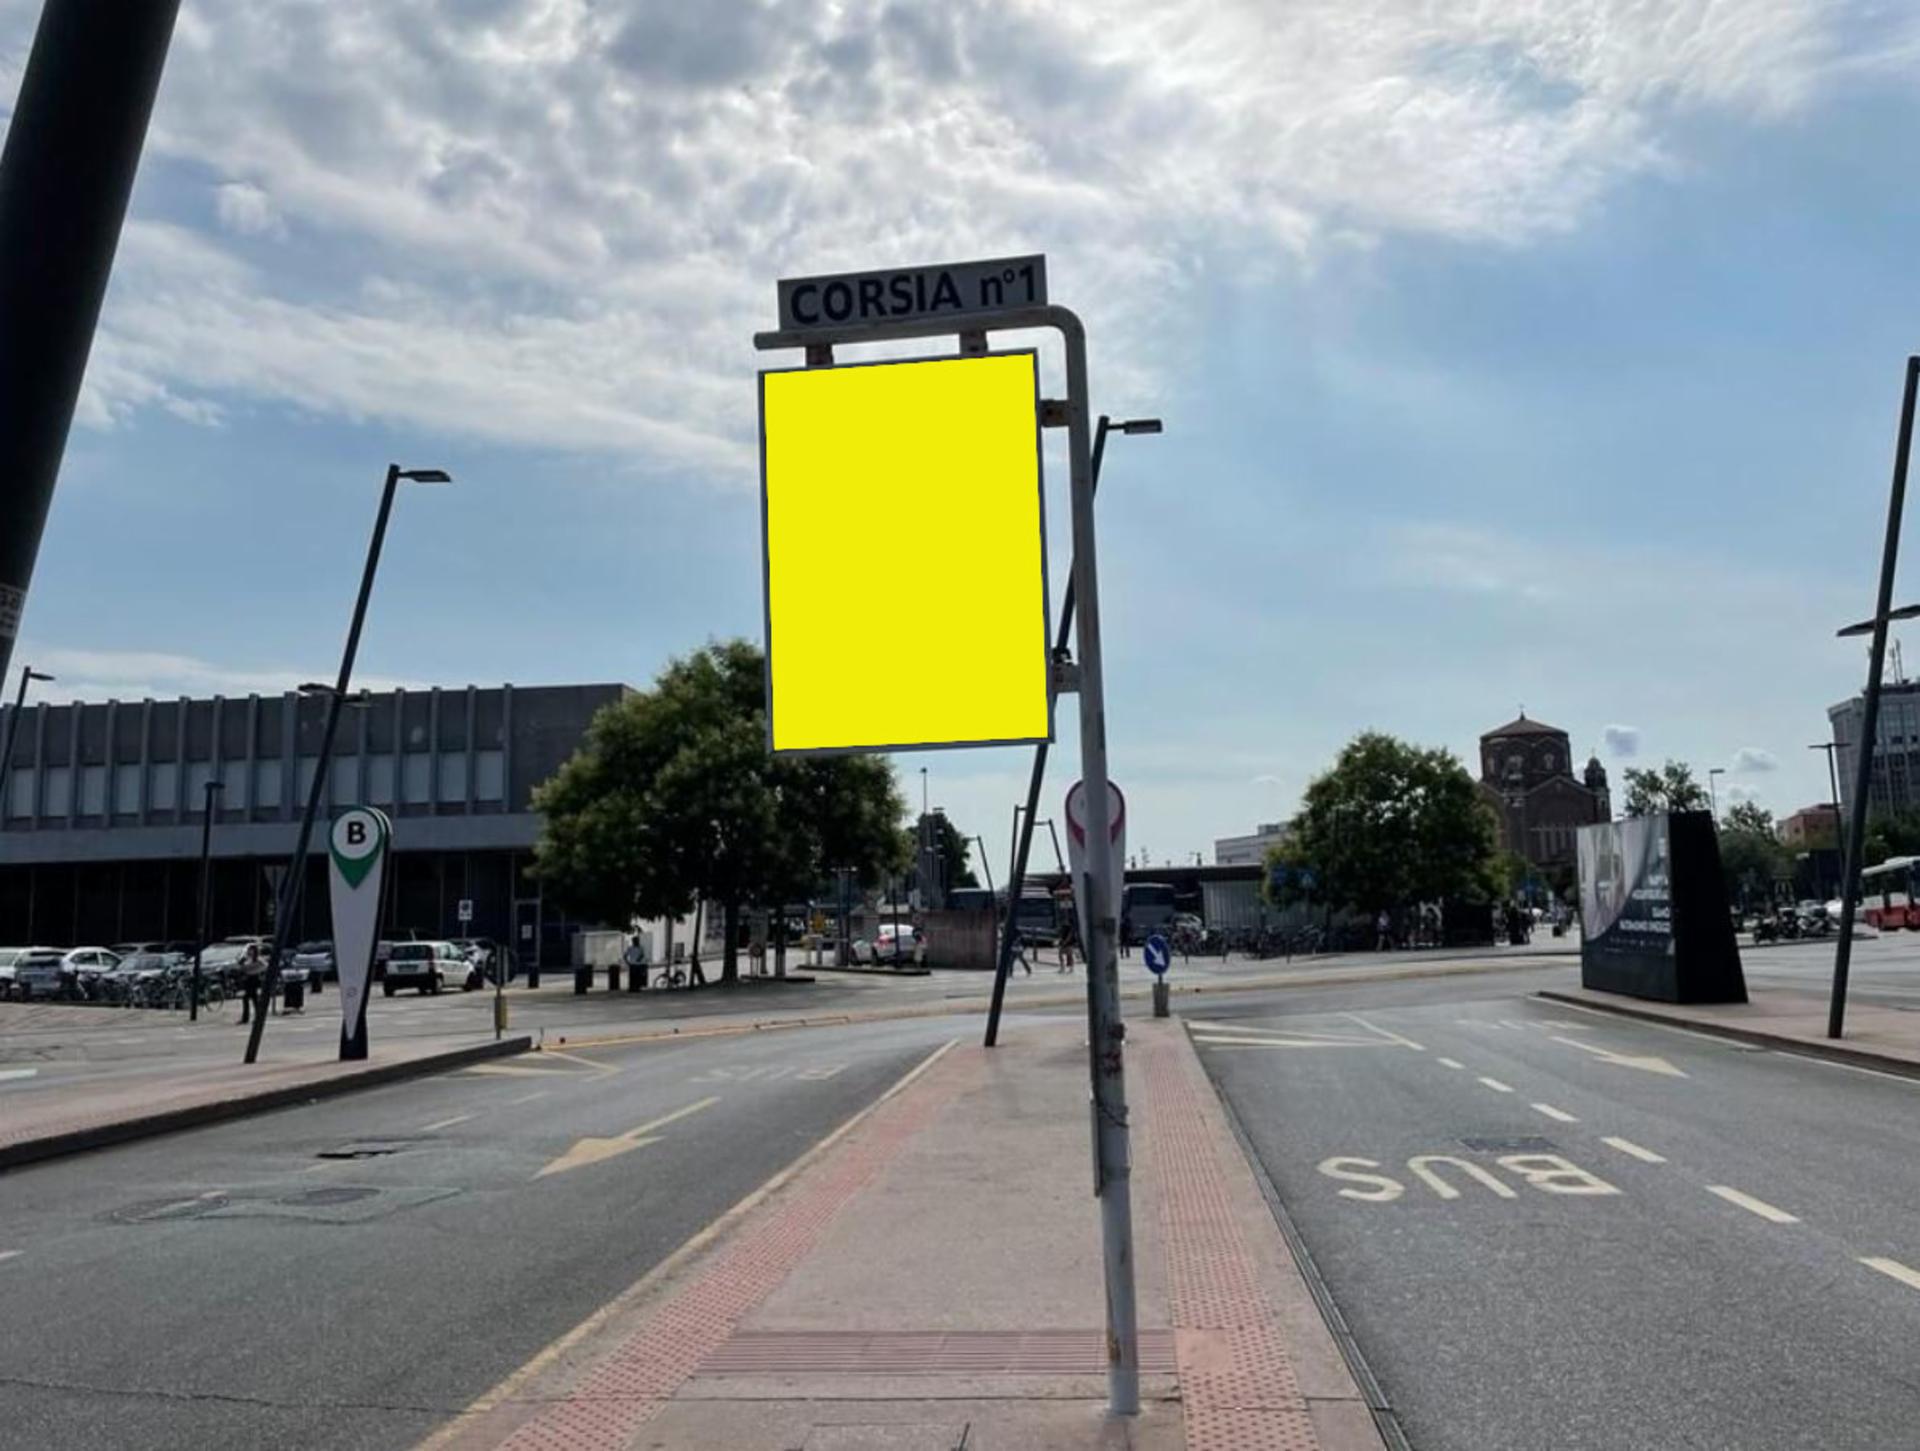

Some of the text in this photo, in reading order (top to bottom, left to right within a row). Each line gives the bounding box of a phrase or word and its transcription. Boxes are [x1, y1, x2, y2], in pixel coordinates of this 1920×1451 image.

[790, 271, 963, 325] CORSIA
[347, 821, 366, 845] B
[1316, 1154, 1624, 1201] BUS
